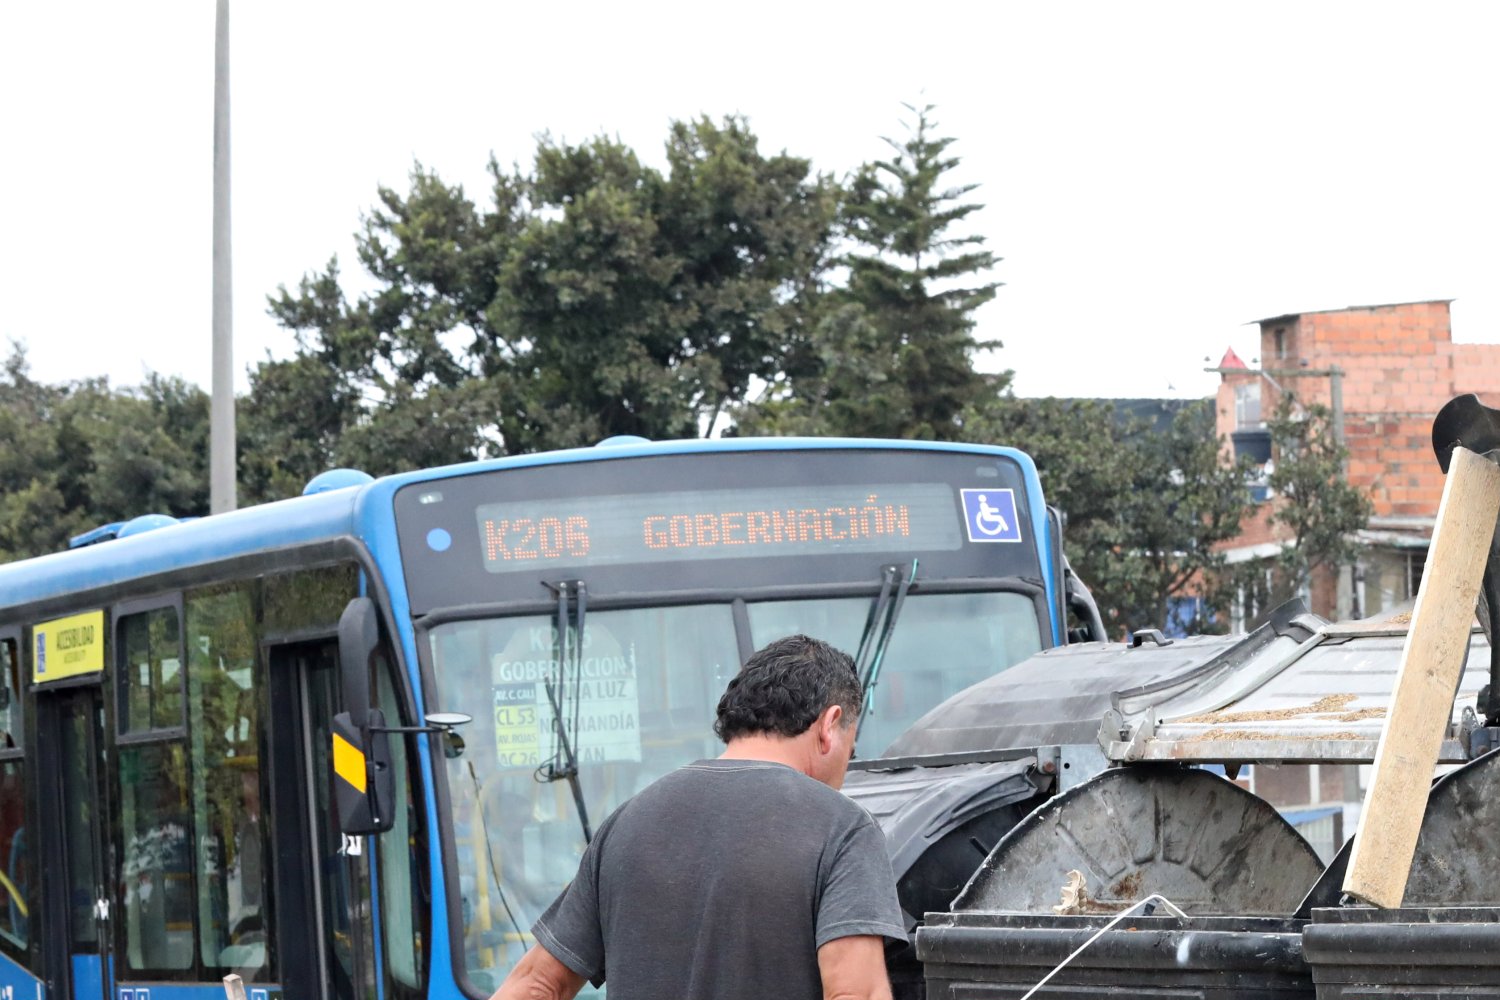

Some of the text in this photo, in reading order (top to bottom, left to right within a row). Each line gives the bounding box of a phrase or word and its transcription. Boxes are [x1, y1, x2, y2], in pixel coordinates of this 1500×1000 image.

[484, 495, 910, 561] K206 GOBERNACIÓN
[597, 681, 627, 698] LUZ
[497, 707, 535, 726] CL 53
